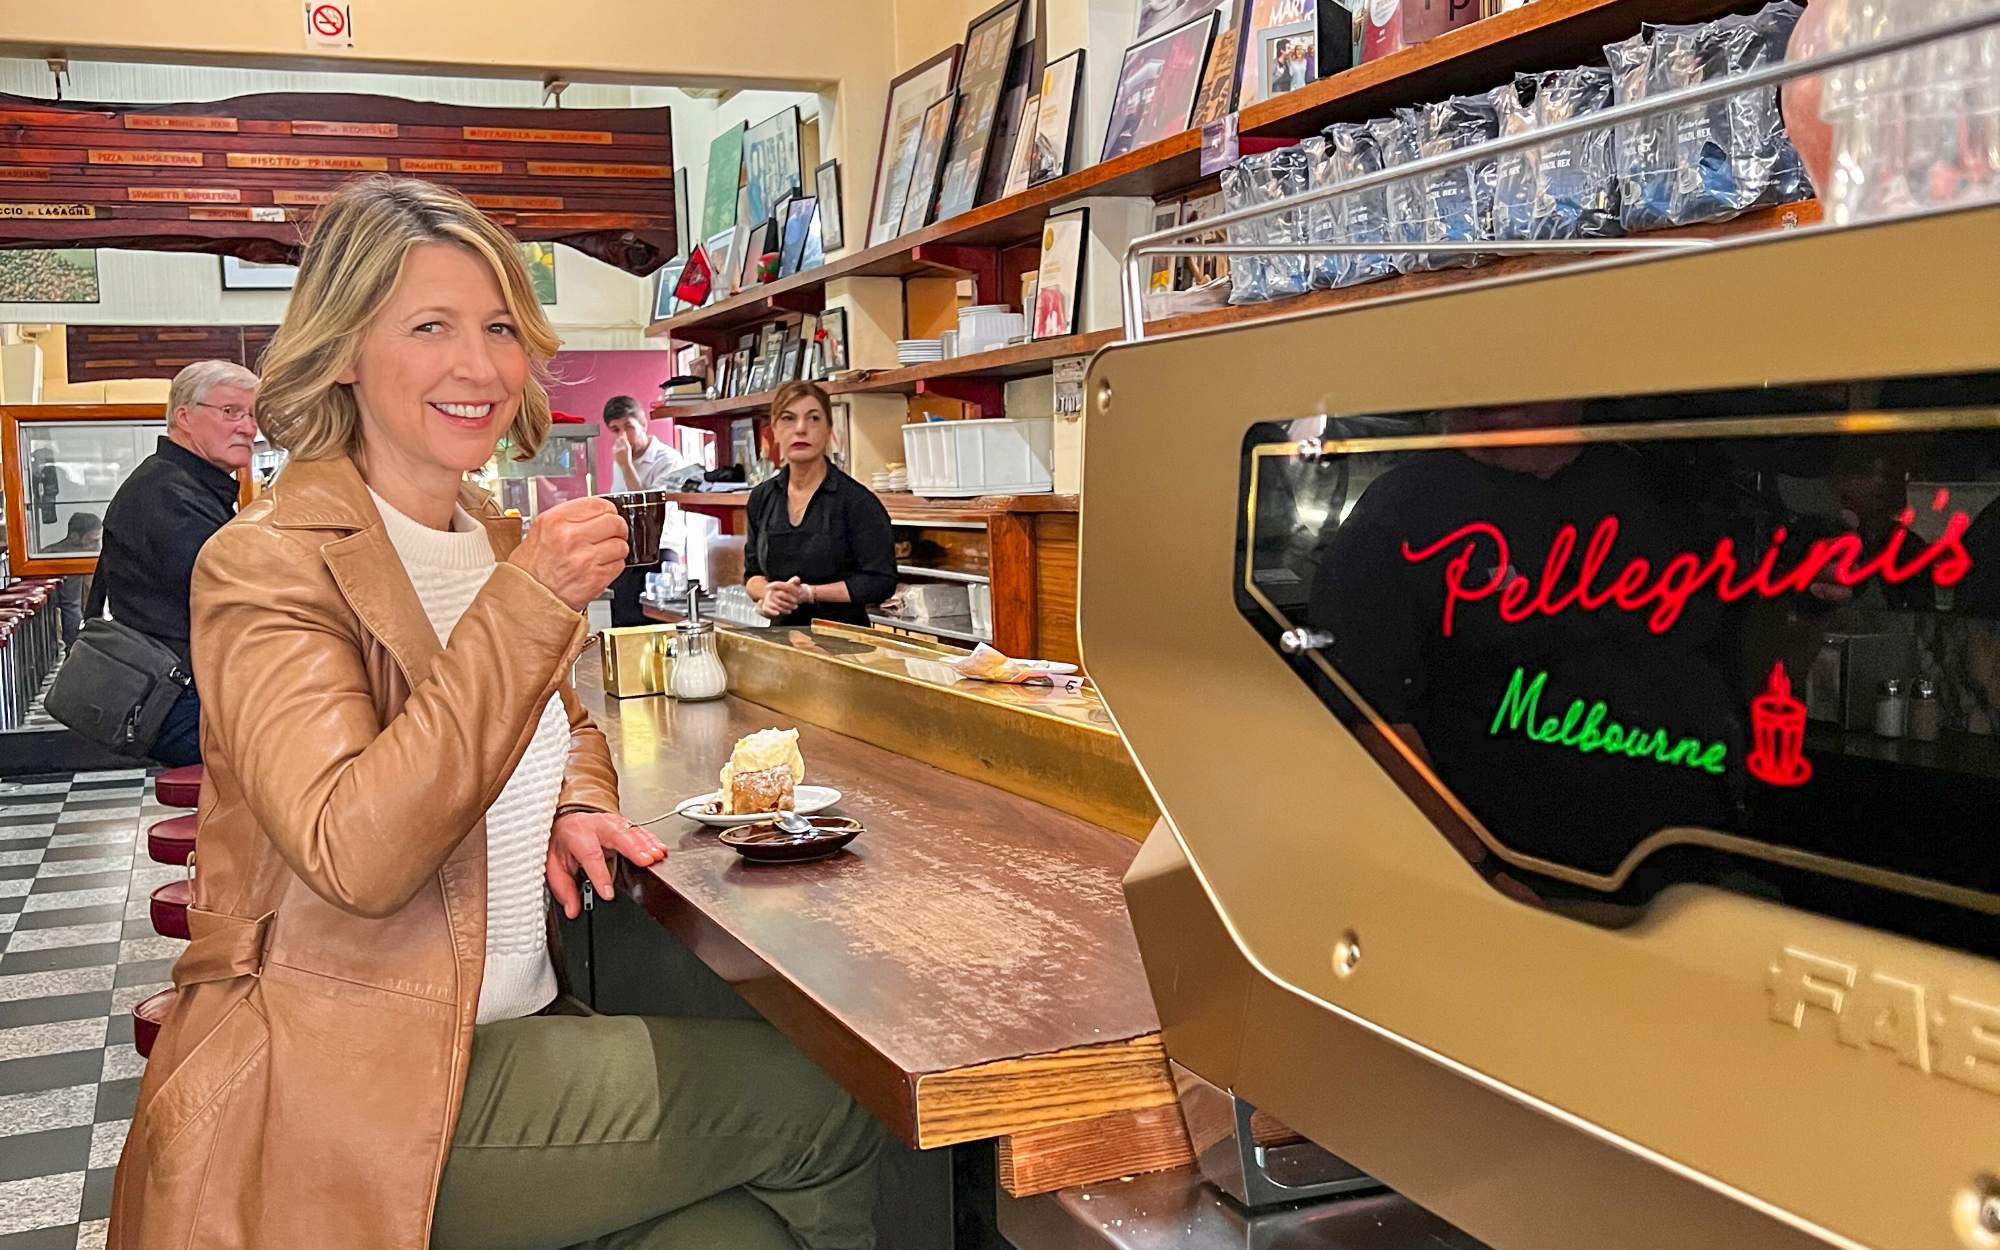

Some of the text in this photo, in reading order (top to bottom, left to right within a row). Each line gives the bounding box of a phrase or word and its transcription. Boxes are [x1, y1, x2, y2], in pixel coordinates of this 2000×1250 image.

[98, 152, 122, 162] PIZZA
[250, 157, 364, 168] RISOTTO PRIMAVERA
[1402, 487, 1972, 637] Pellegrini's
[1490, 666, 1727, 774] Melbourne
